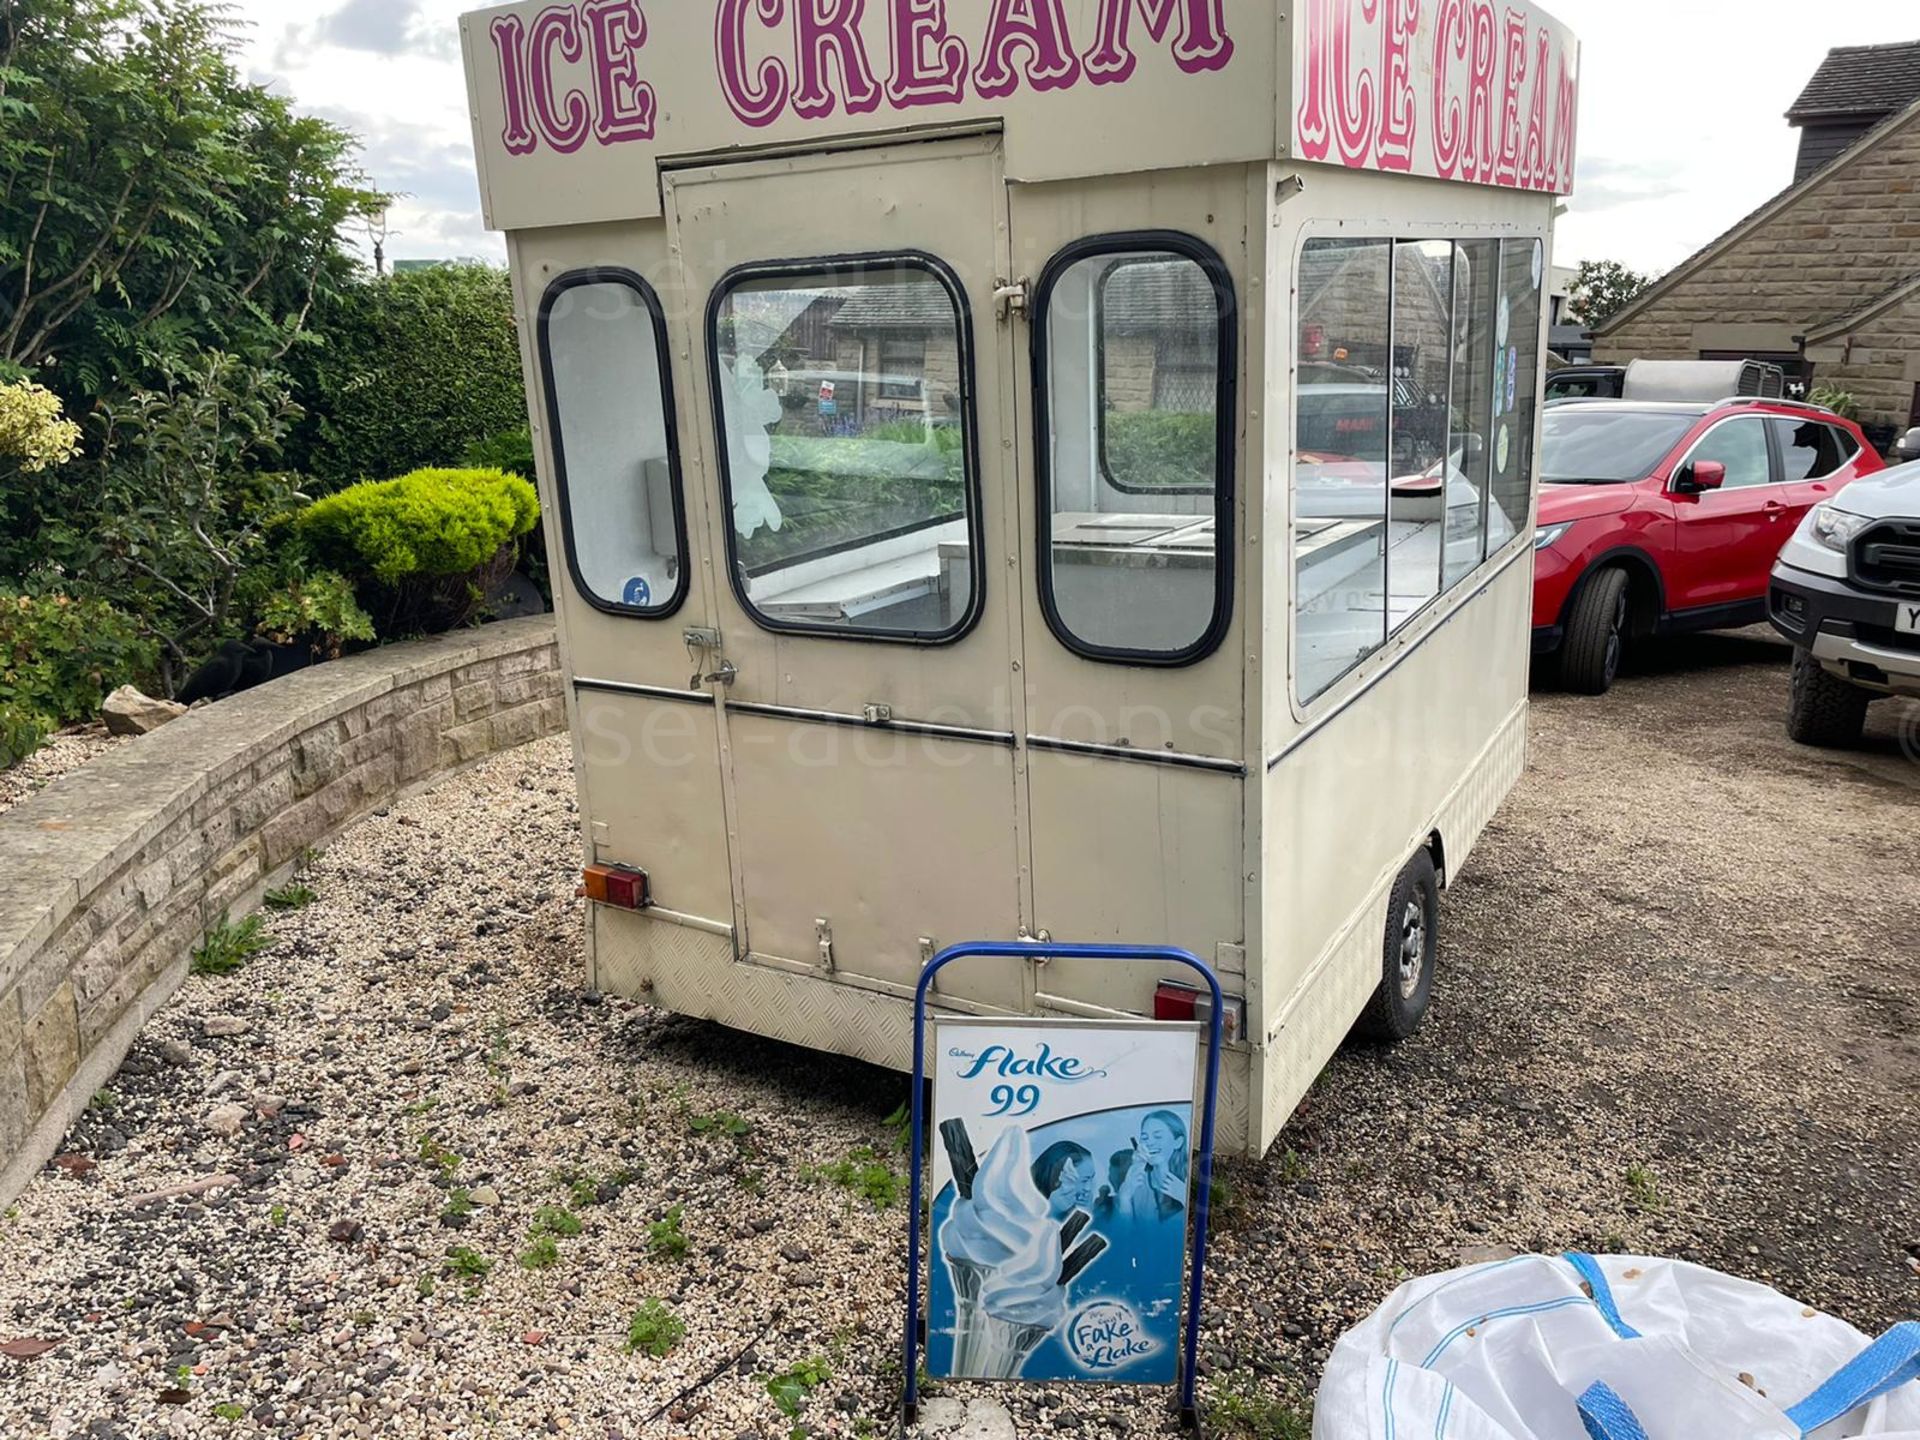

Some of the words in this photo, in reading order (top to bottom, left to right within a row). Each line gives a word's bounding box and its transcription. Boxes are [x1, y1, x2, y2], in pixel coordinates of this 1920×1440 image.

[490, 0, 658, 156] ICE
[714, 0, 1235, 128] CREAM
[1298, 0, 1418, 171] ICE
[1431, 0, 1574, 195] CREAM
[982, 1084, 1041, 1117] 99
[1077, 1322, 1133, 1346] Fake
[1085, 1343, 1095, 1352] a
